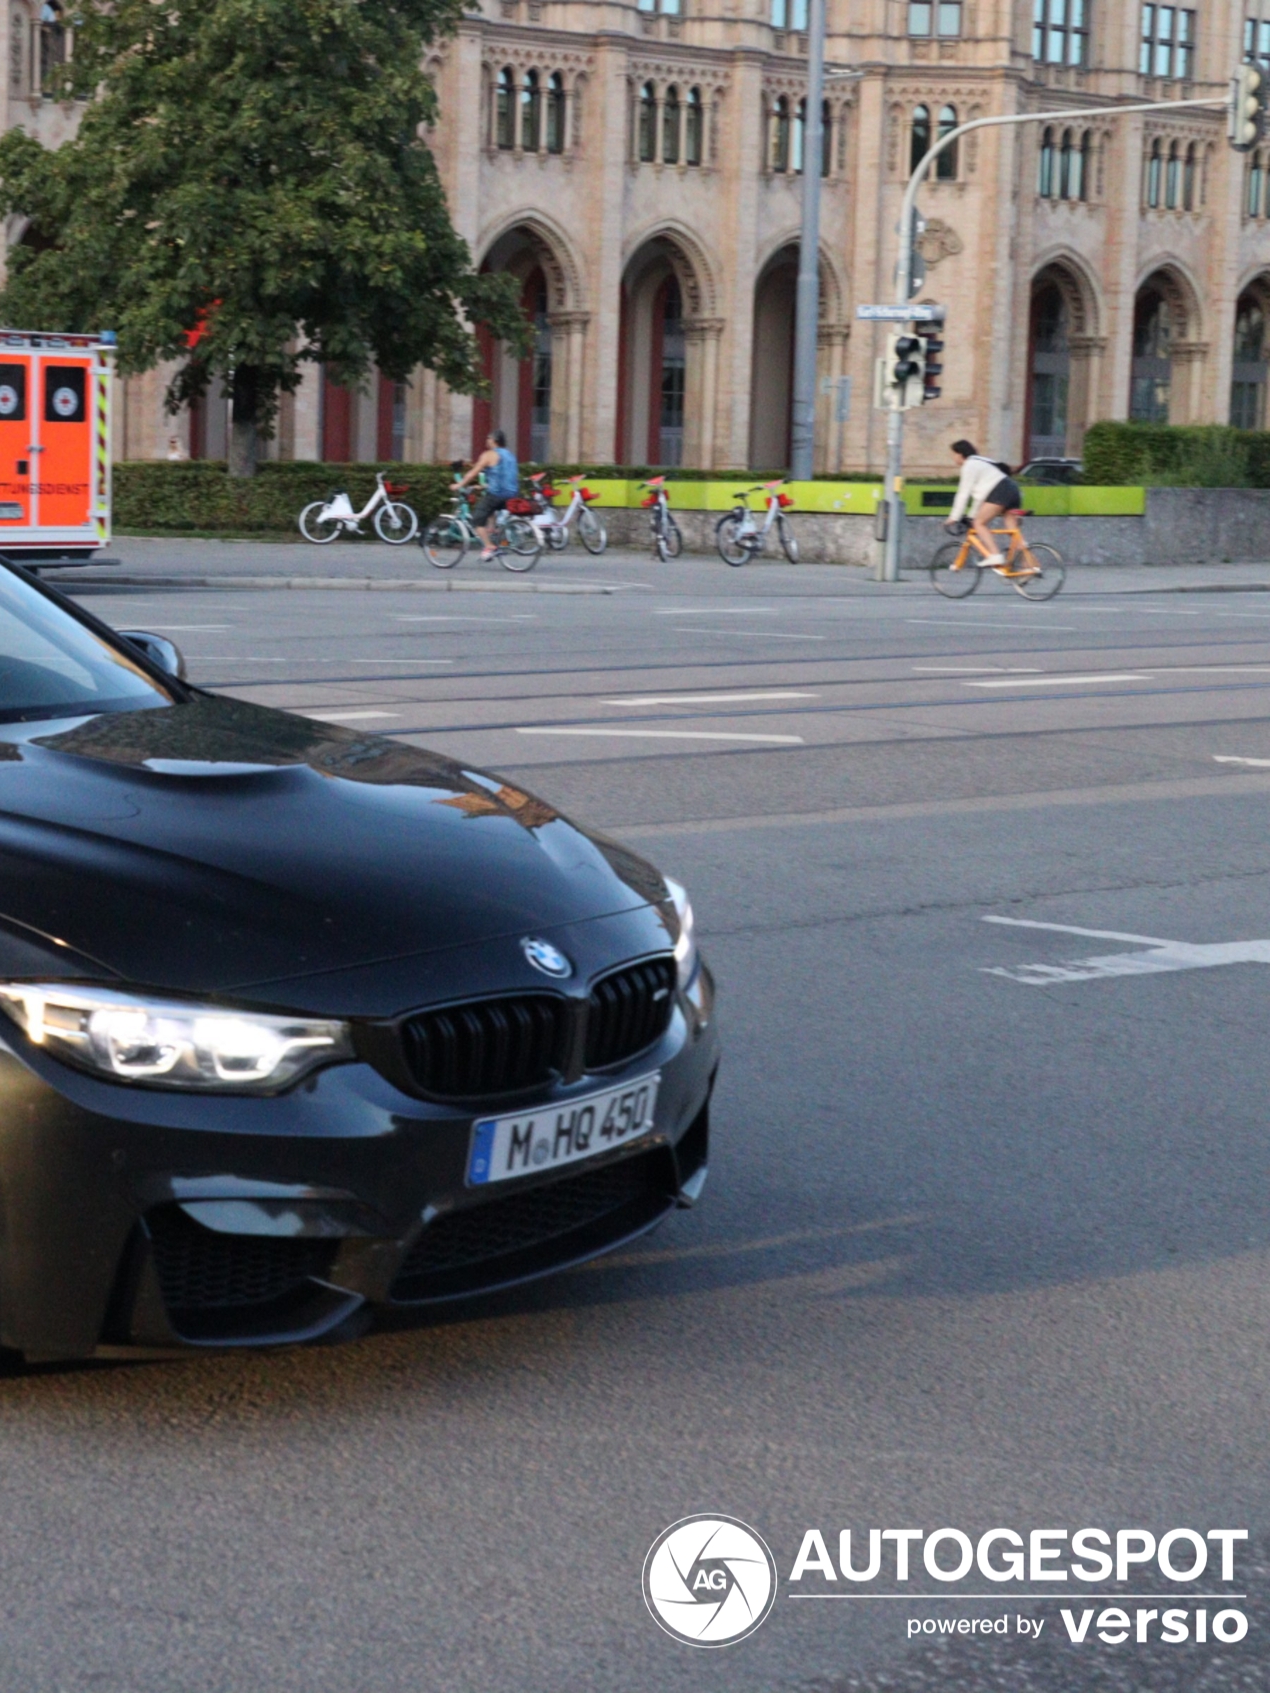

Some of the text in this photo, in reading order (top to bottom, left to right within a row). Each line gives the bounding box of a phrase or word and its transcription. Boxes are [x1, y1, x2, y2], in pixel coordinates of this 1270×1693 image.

[506, 1121, 535, 1171] M
[553, 1106, 595, 1159] HQ
[599, 1086, 649, 1142] 450
